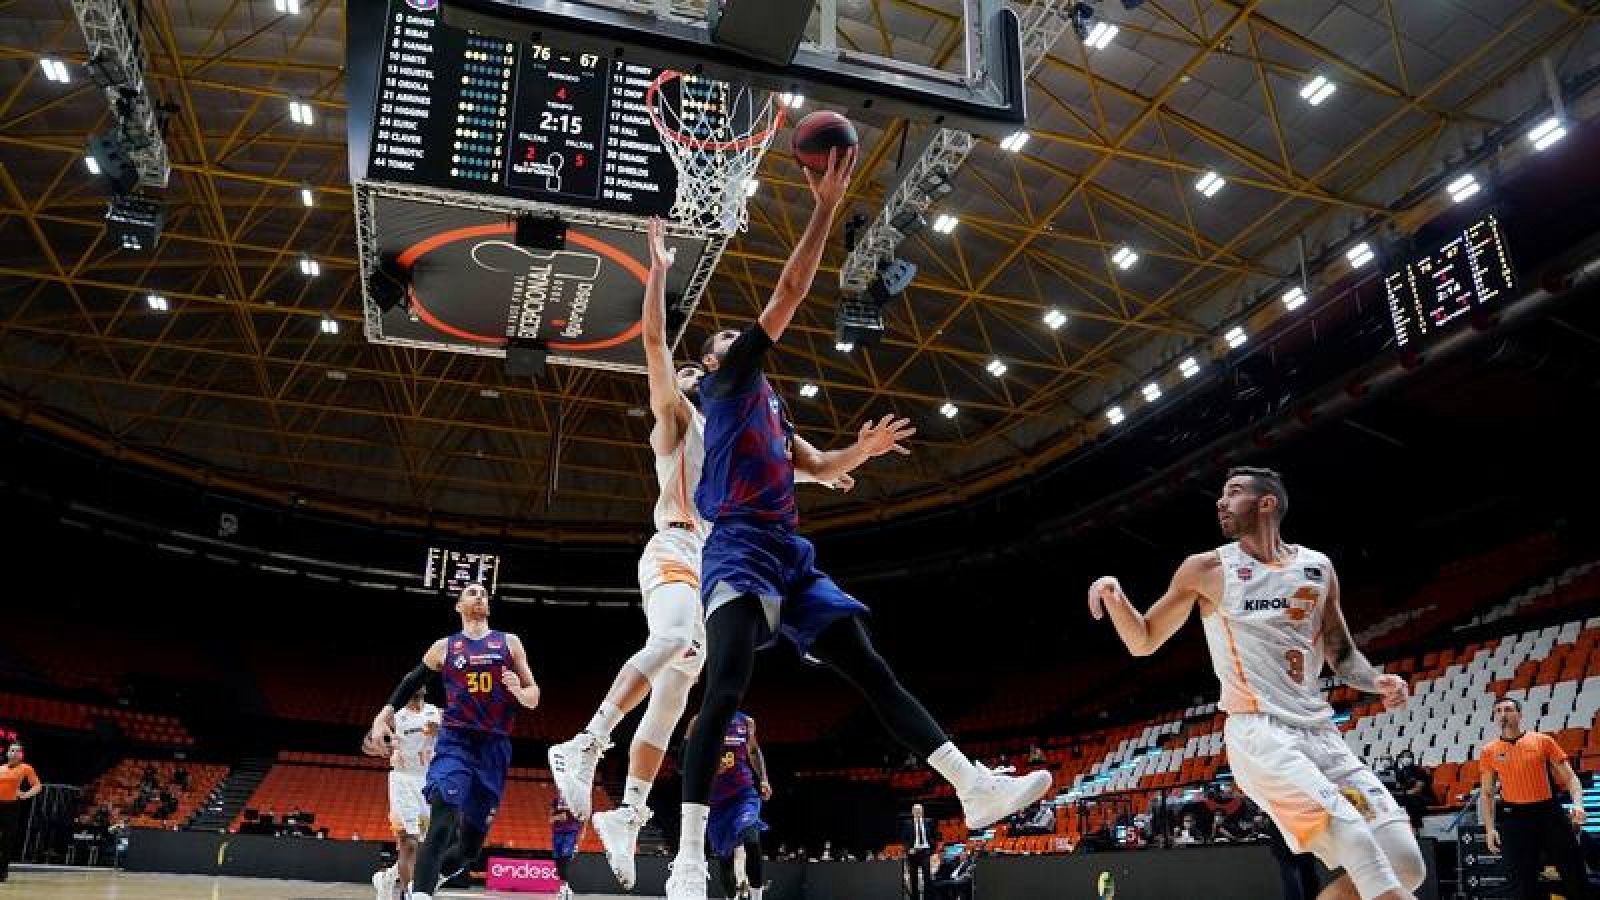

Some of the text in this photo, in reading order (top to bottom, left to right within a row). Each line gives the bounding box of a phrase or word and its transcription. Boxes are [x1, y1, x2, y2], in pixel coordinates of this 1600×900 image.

[395, 13, 402, 22] 0
[532, 45, 550, 60] 76
[580, 53, 598, 68] 67
[616, 61, 624, 70] 7
[556, 87, 567, 100] 4
[540, 112, 582, 134] 2:15
[527, 145, 536, 160] 2
[517, 264, 553, 338] EXCEPCIONAL
[466, 672, 493, 693] 30
